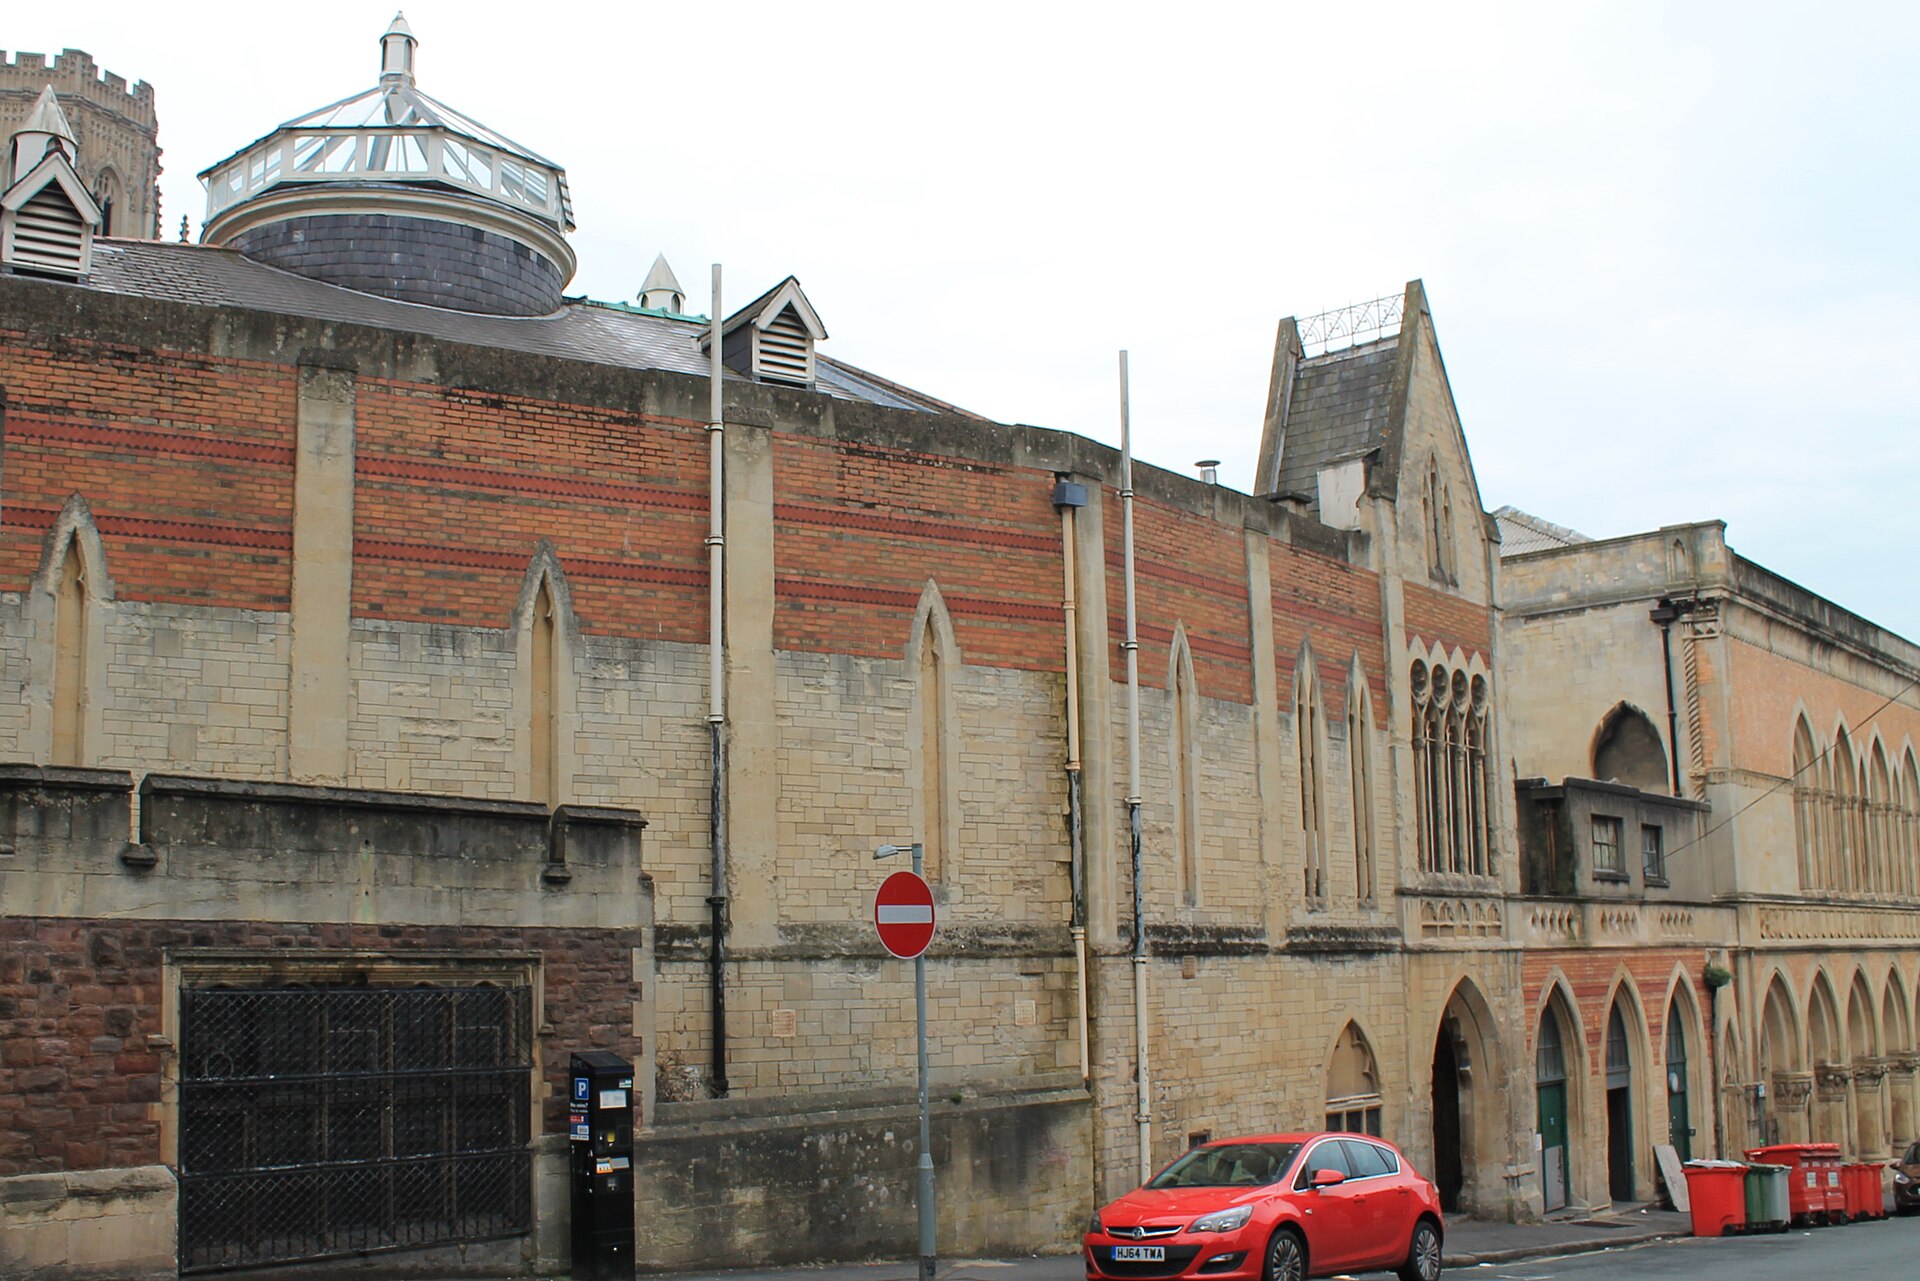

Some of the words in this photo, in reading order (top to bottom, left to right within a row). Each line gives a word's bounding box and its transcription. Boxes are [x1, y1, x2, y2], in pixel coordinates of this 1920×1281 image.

[578, 1082, 586, 1096] P
[1117, 1248, 1141, 1259] HJ64
[1143, 1248, 1163, 1259] TWA
